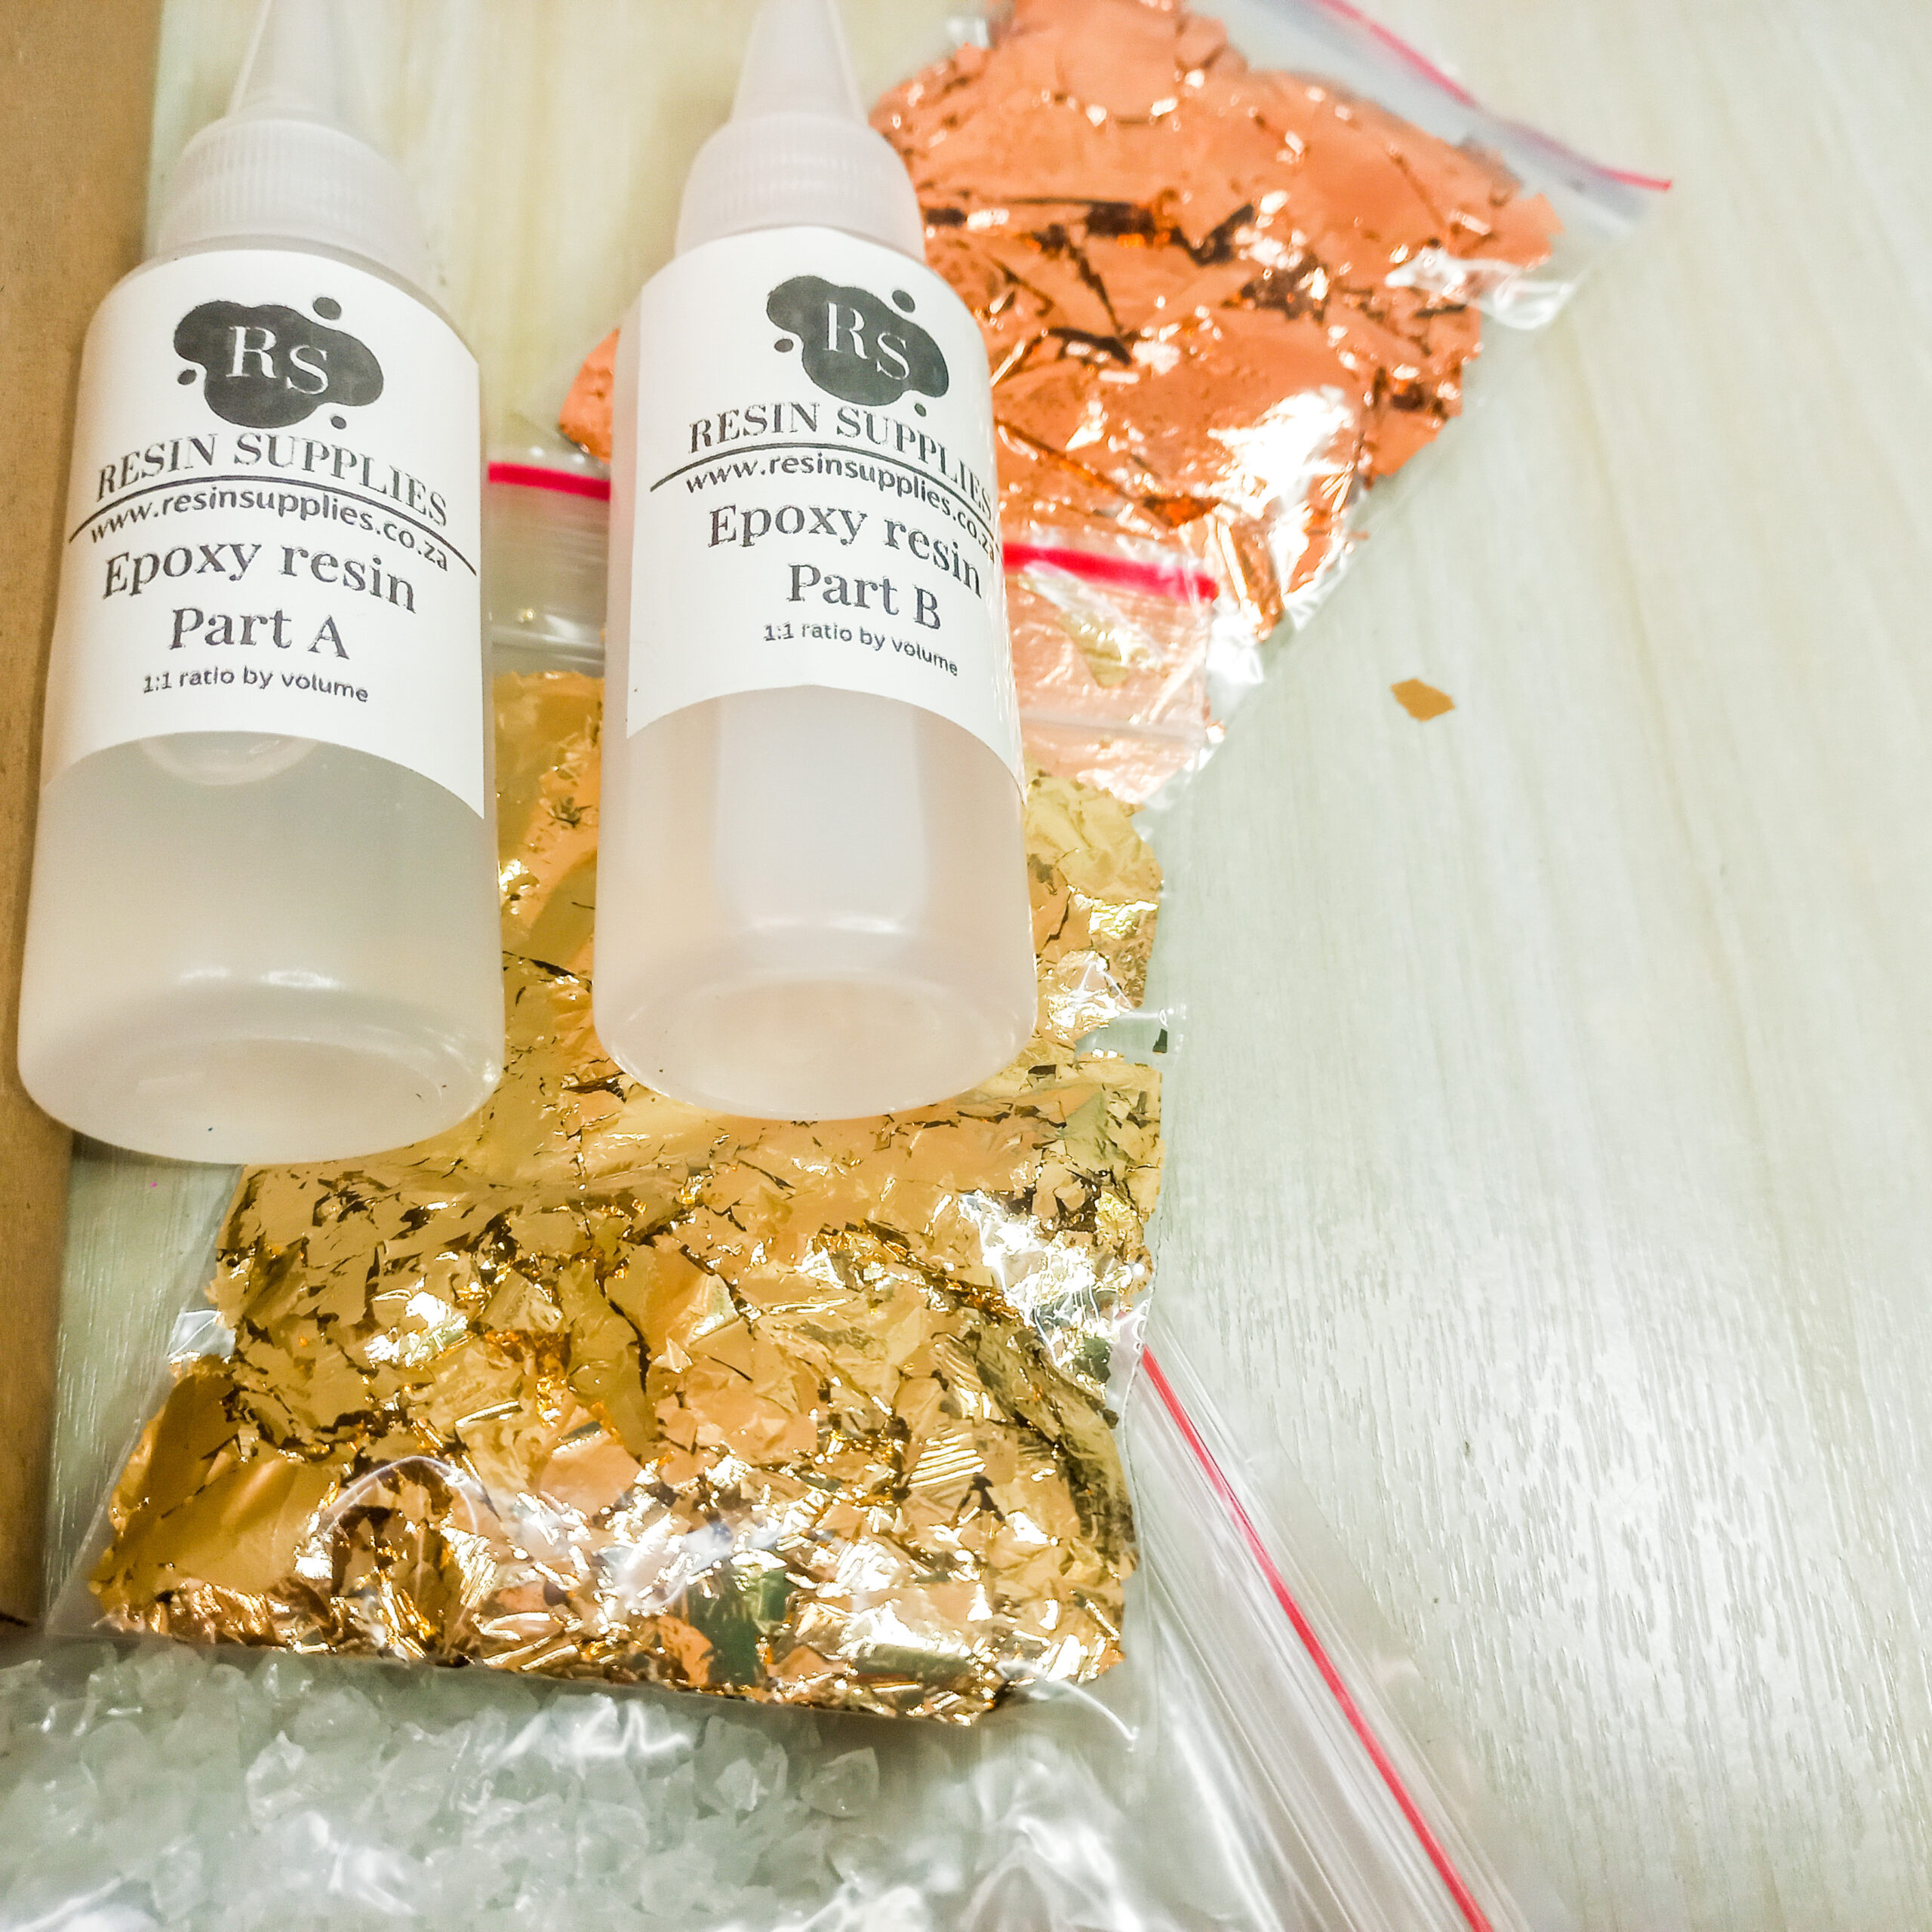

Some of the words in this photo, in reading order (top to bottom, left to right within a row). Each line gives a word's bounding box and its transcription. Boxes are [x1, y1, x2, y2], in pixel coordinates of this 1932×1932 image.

[226, 326, 329, 394] RS
[823, 303, 910, 380] RS
[95, 433, 217, 502] RESIN
[234, 433, 447, 527] SUPPLIES
[689, 401, 820, 454] RESIN
[836, 406, 992, 521] SUPPLIES
[90, 486, 448, 572] www.resinsupplies.co.za
[708, 504, 868, 548] Epoxy
[883, 517, 982, 599] resin
[103, 543, 262, 599] Epoxy
[280, 543, 417, 614] resin
[787, 563, 900, 615] Part
[913, 586, 941, 630] B
[168, 607, 293, 650] Part
[309, 615, 350, 660] A
[764, 623, 792, 641] 1:1
[801, 623, 852, 642] ratio
[860, 628, 885, 651] by
[892, 637, 958, 676] volume
[143, 673, 172, 694] 1:1
[180, 666, 234, 688] ratio
[243, 666, 273, 689] by
[281, 674, 368, 703] volume
